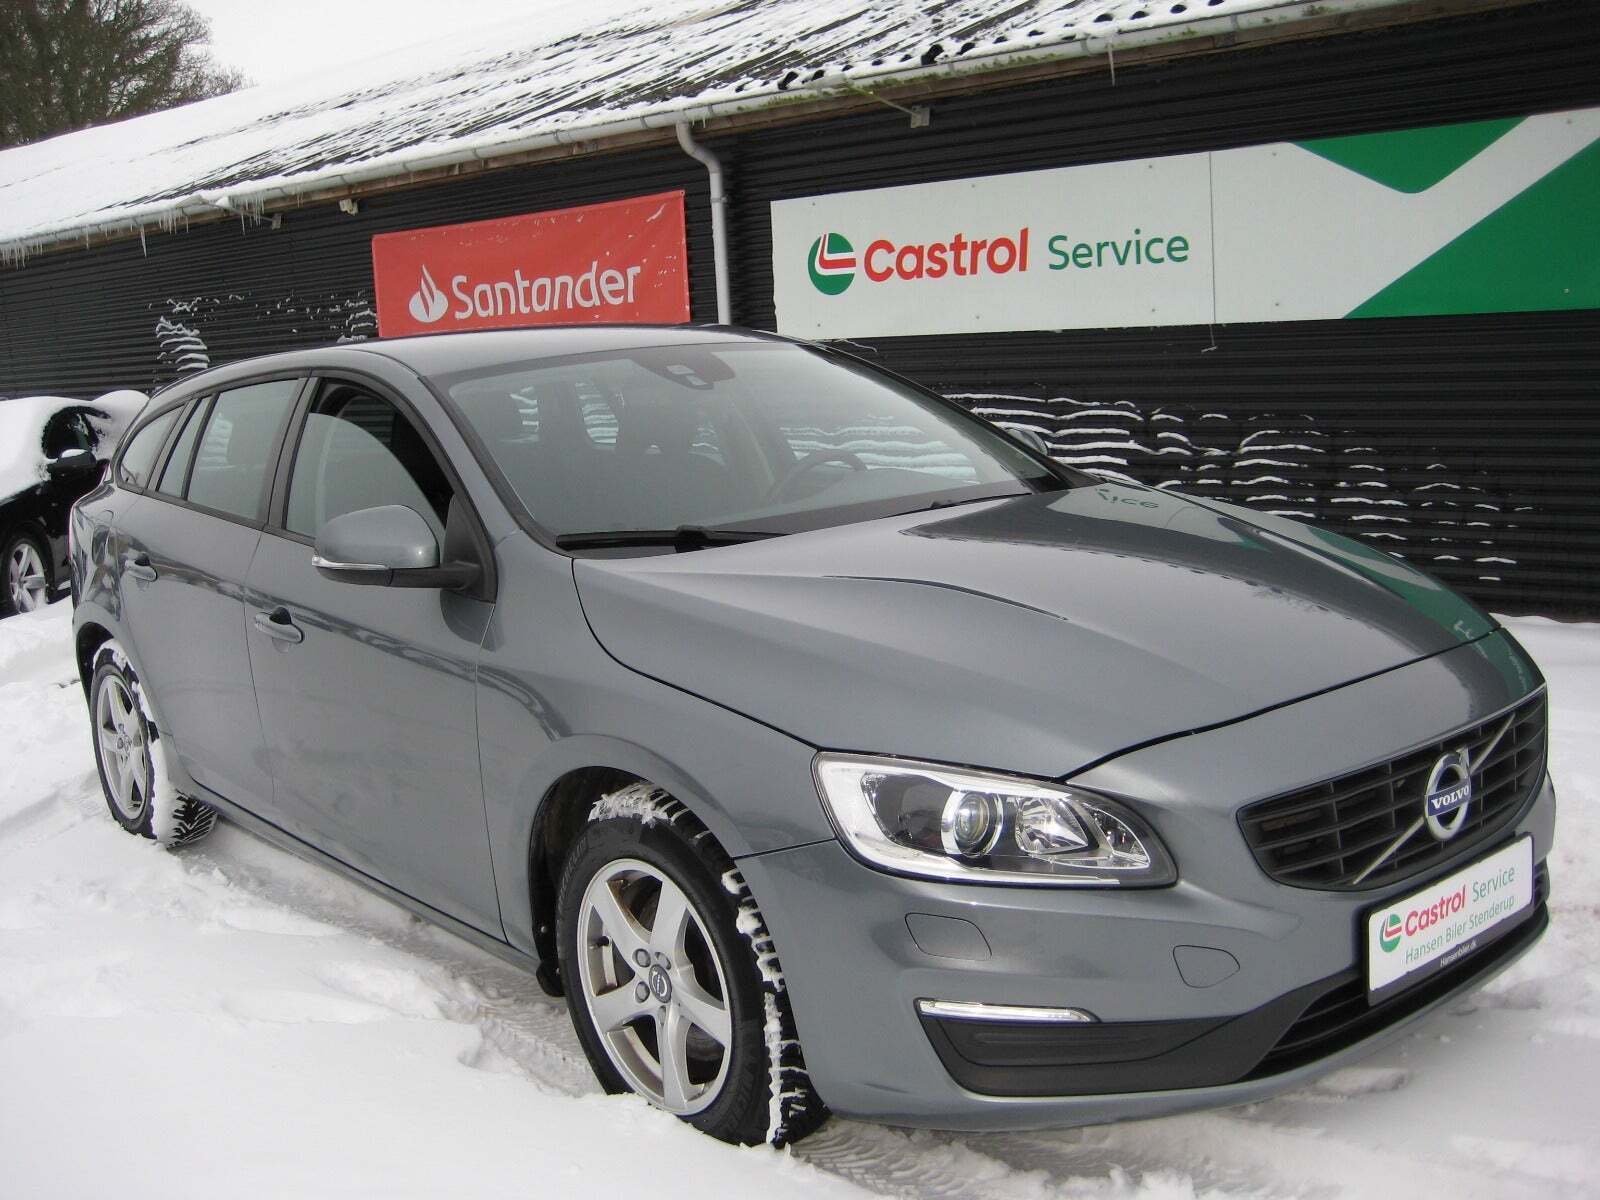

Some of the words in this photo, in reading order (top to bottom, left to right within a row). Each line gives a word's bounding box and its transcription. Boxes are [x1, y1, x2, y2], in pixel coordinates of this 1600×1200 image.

[864, 227, 1029, 283] Castrol
[1048, 228, 1190, 271] Service
[452, 260, 641, 320] Santander
[1431, 785, 1469, 809] VOLVO
[1405, 884, 1466, 937] Castrol
[1472, 867, 1515, 902] Service
[1405, 931, 1443, 965] Hansen
[1445, 921, 1468, 944] Biler
[1469, 895, 1515, 930] Stenderup
